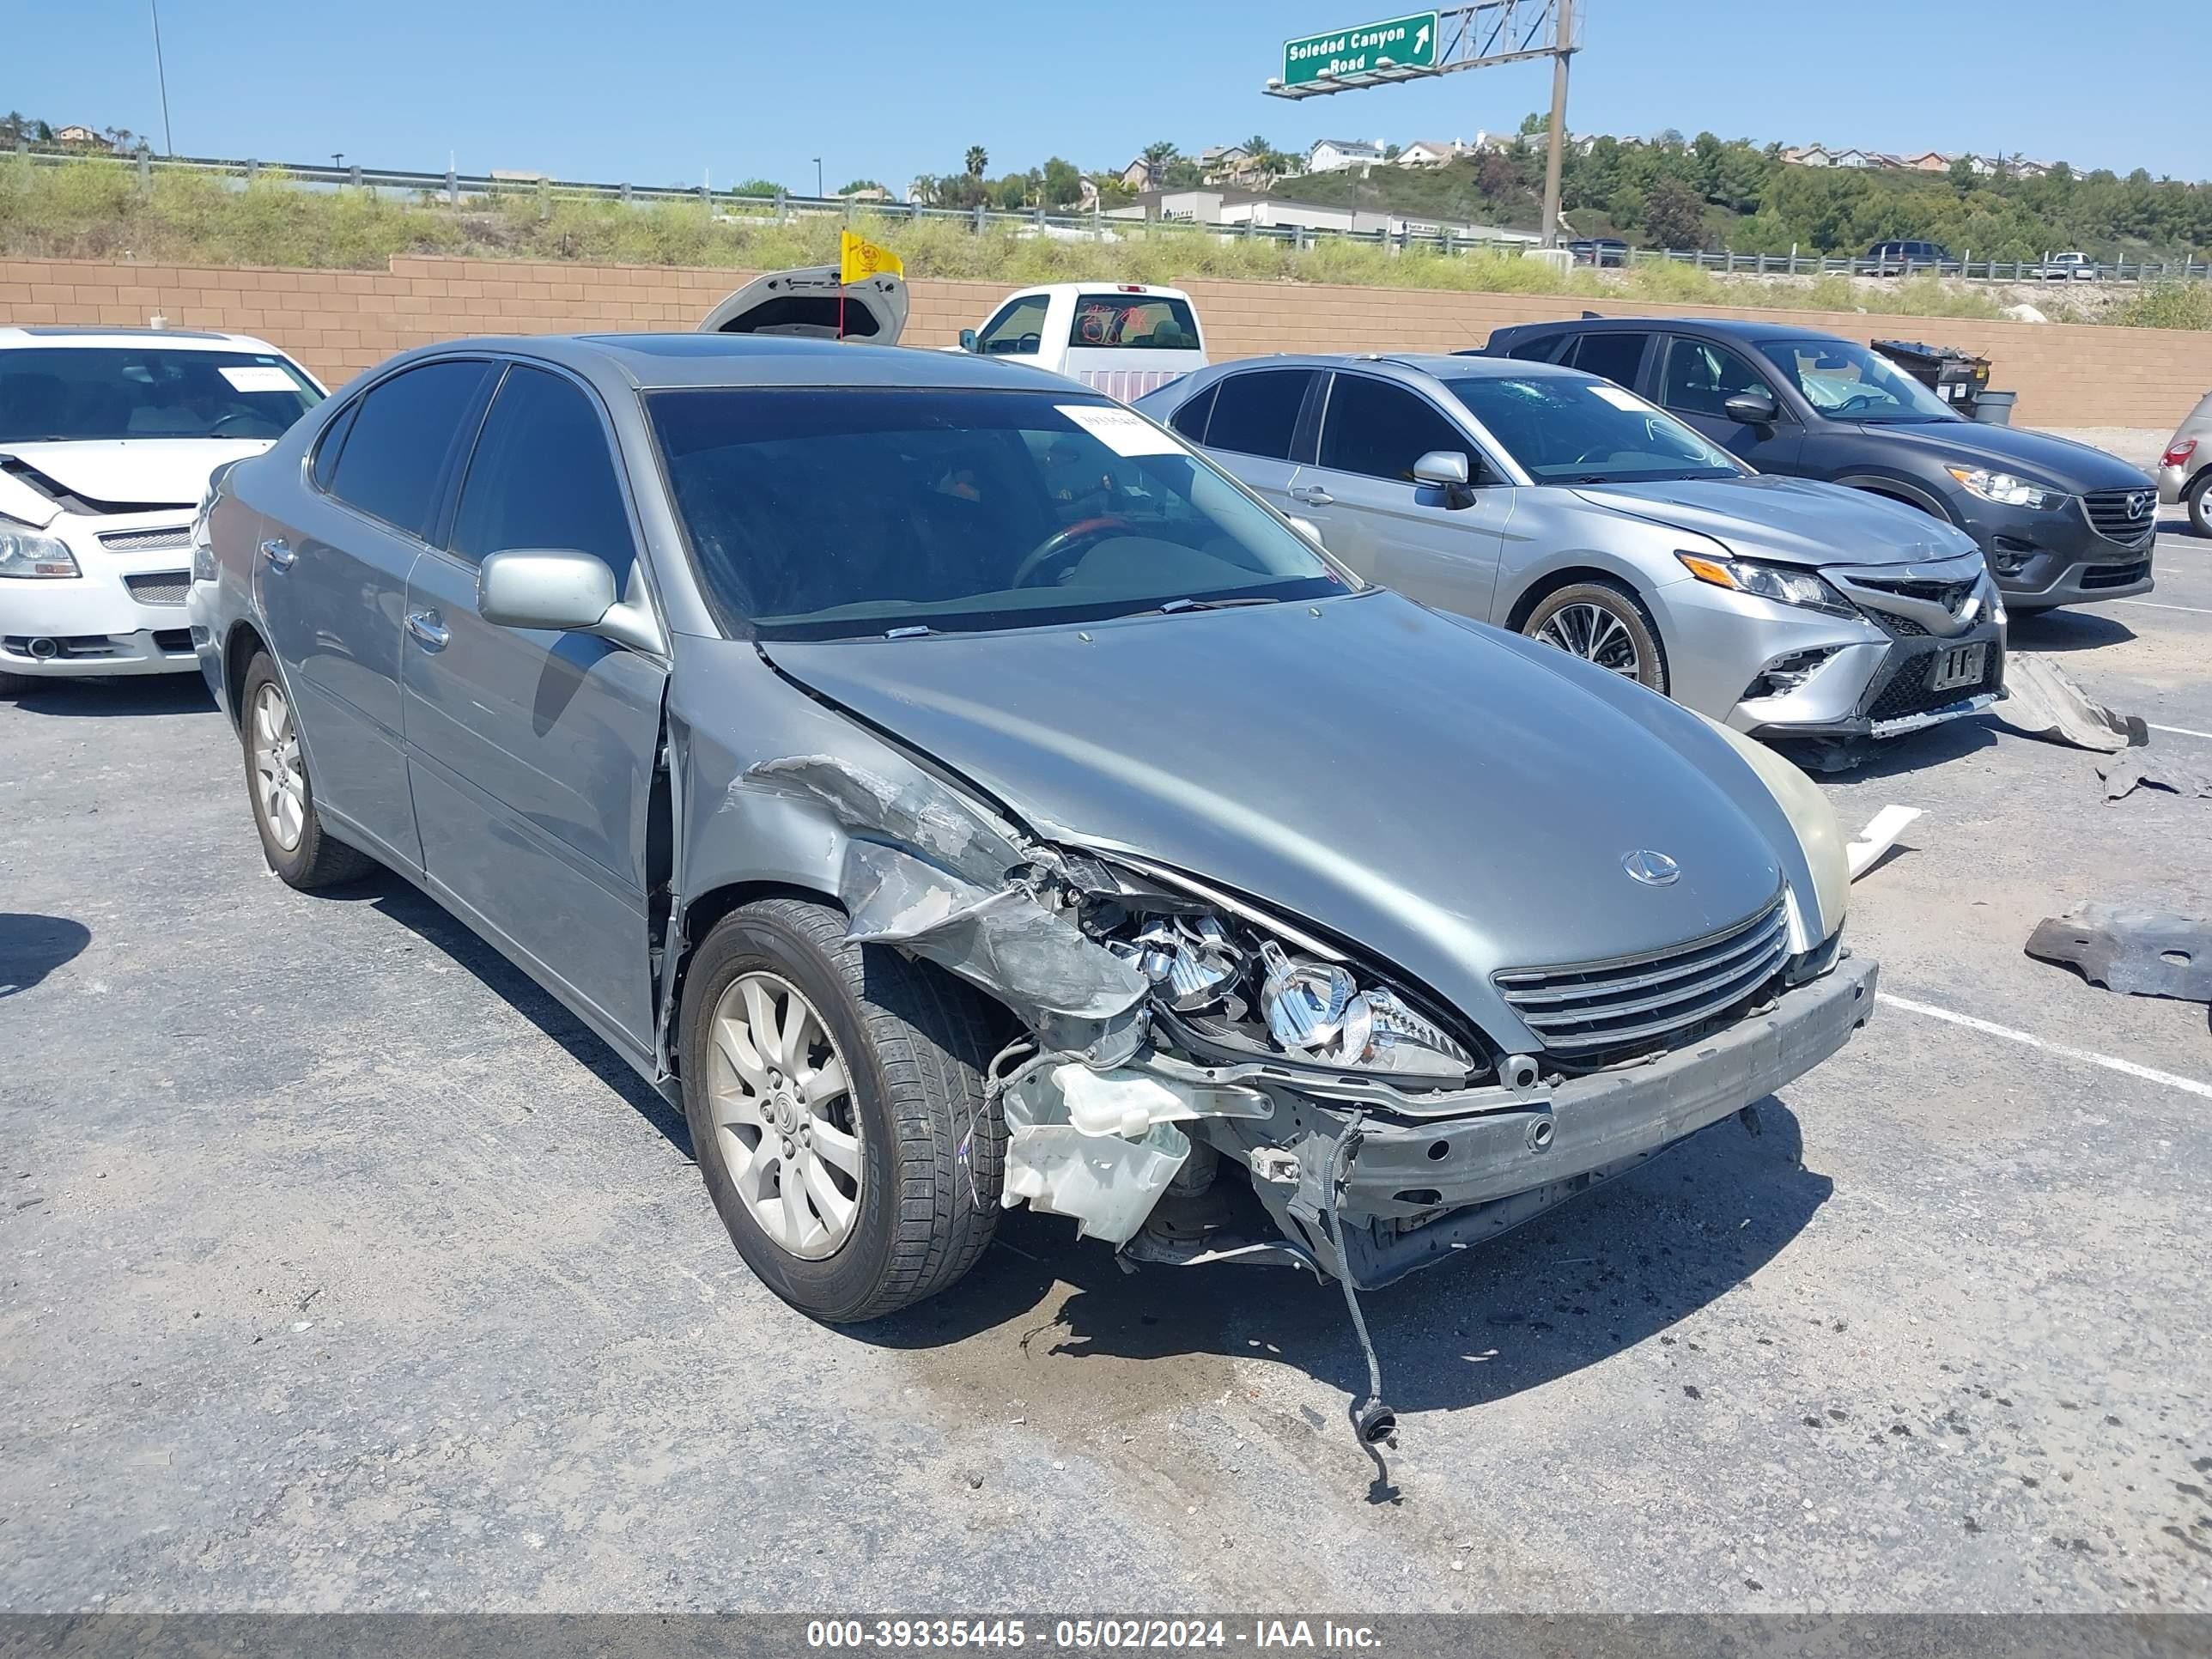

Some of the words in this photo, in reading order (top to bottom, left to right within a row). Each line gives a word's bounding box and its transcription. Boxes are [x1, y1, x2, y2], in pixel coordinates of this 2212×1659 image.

[1290, 34, 1345, 60] Soledad
[1351, 27, 1405, 48] Canyon
[1330, 55, 1365, 74] Road
